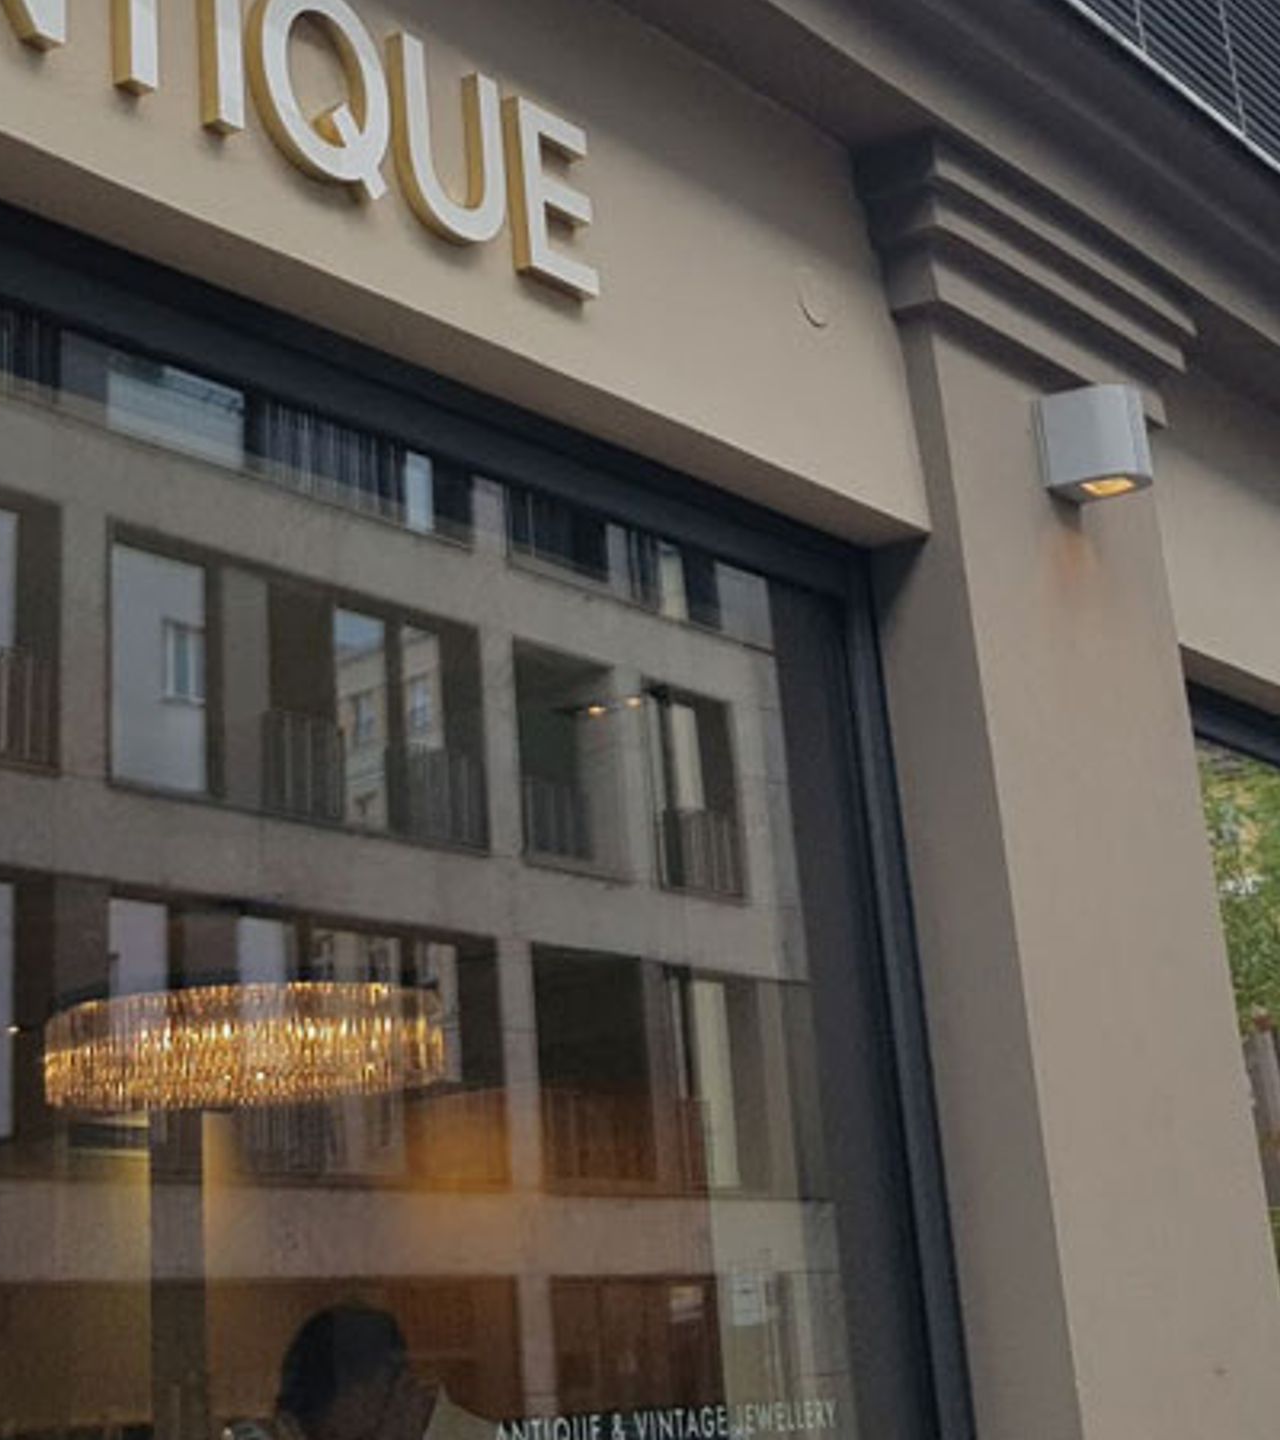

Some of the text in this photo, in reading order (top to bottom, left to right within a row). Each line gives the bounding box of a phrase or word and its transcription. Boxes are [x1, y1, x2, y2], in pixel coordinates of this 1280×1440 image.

[611, 1412, 627, 1440] &
[632, 1405, 728, 1440] VINTAGE
[731, 1400, 838, 1436] JEWELLERY
